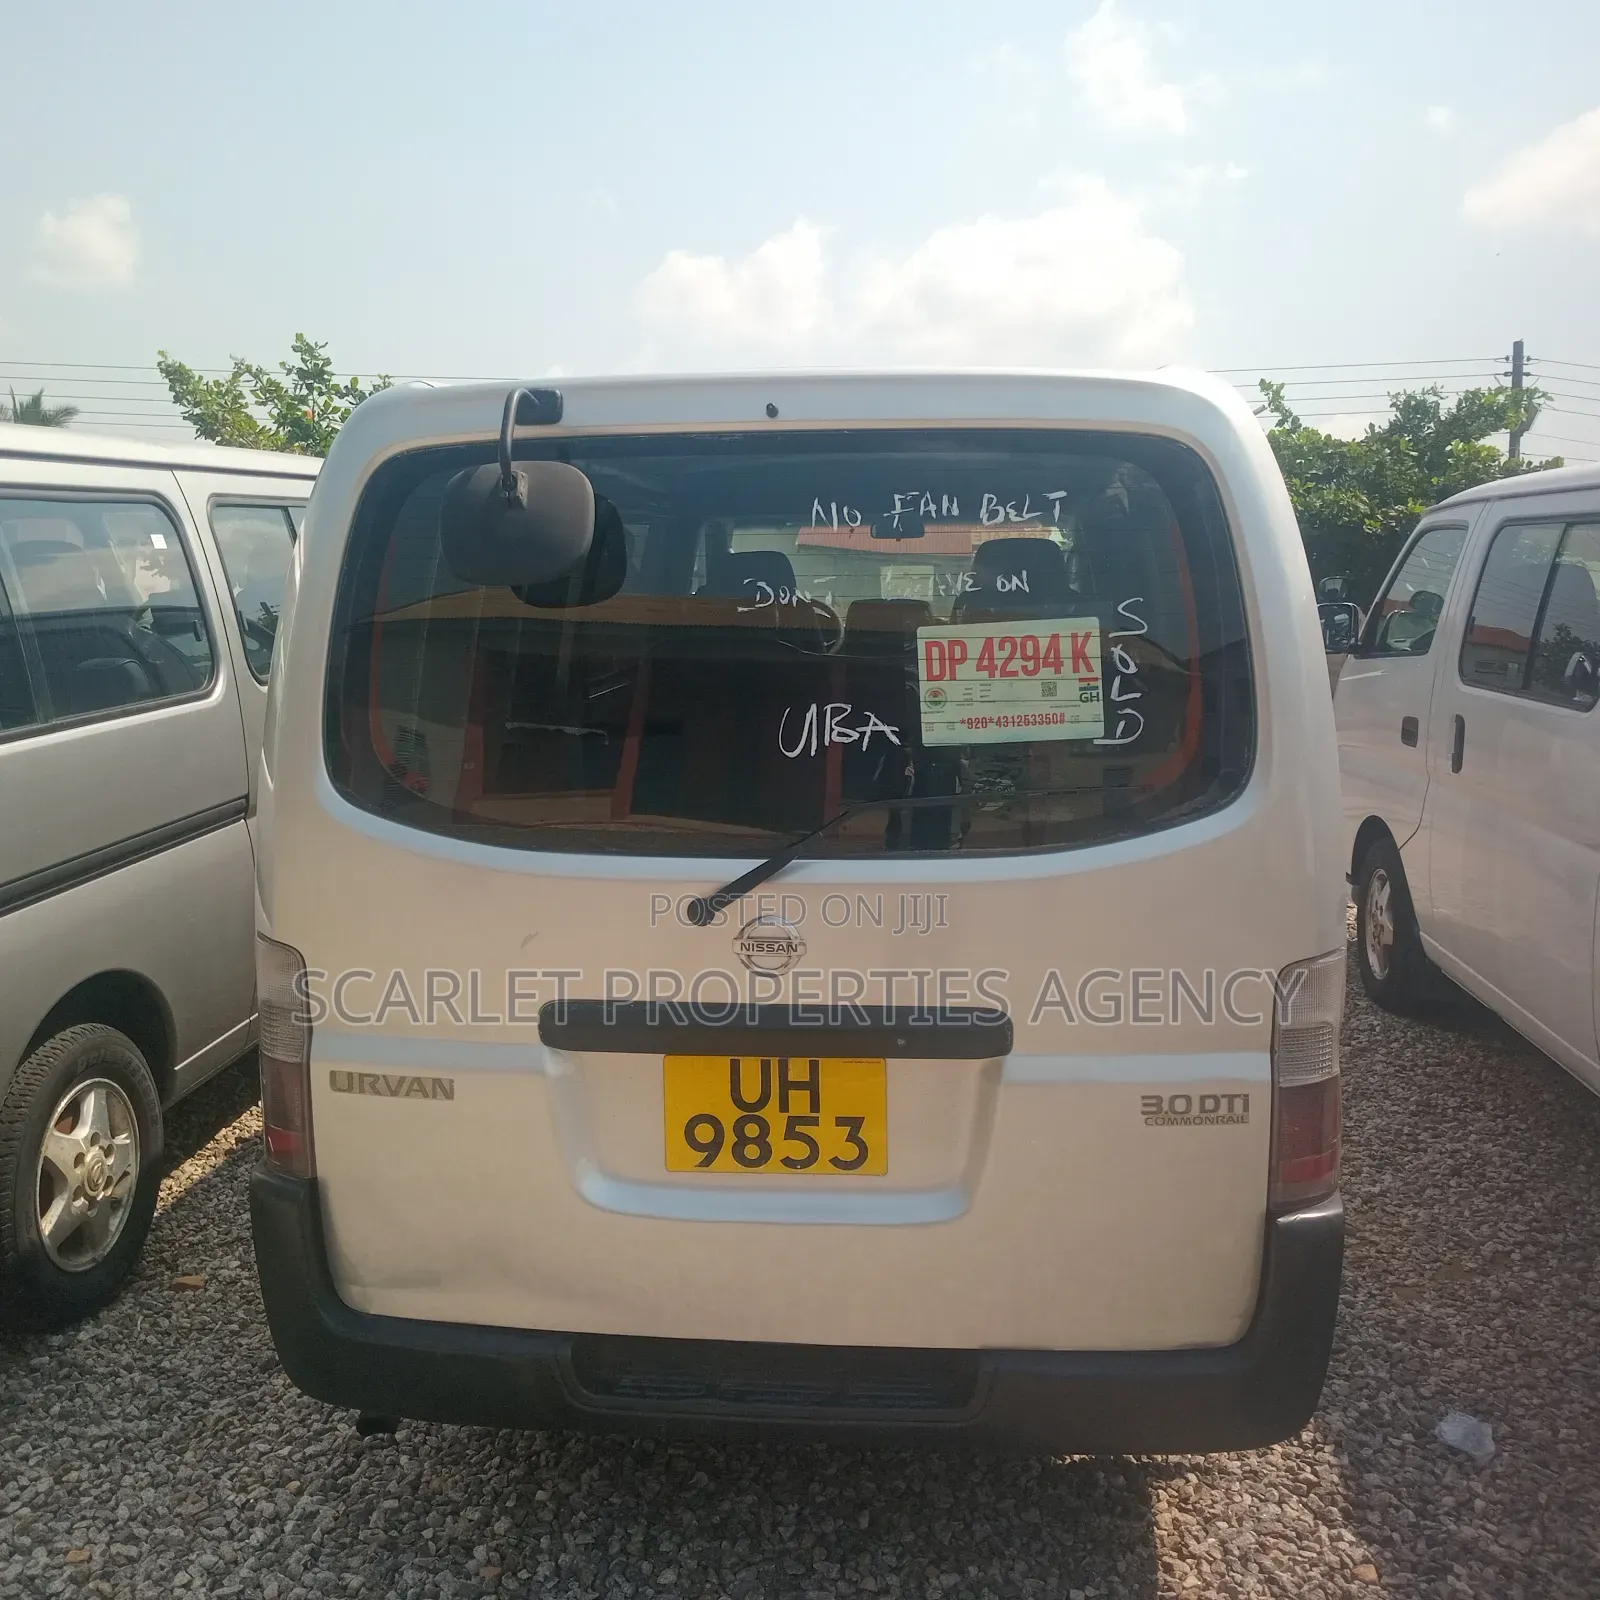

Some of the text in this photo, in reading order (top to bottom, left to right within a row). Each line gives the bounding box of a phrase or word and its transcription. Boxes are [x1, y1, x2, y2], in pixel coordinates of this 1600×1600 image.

[811, 496, 862, 532] NO
[883, 490, 960, 532] FAN
[996, 569, 1030, 593] ON
[925, 631, 1095, 682] DP 4294 K
[1093, 597, 1148, 745] SOLD
[1079, 692, 1100, 703] GH
[779, 703, 901, 758] UBA
[740, 942, 798, 954] NISSAN
[329, 1070, 455, 1101] URVAN
[729, 1058, 821, 1114] UH
[1141, 1094, 1192, 1116] 3.0
[1144, 1115, 1250, 1127] COMMONRAIL
[684, 1113, 869, 1171] 9853
